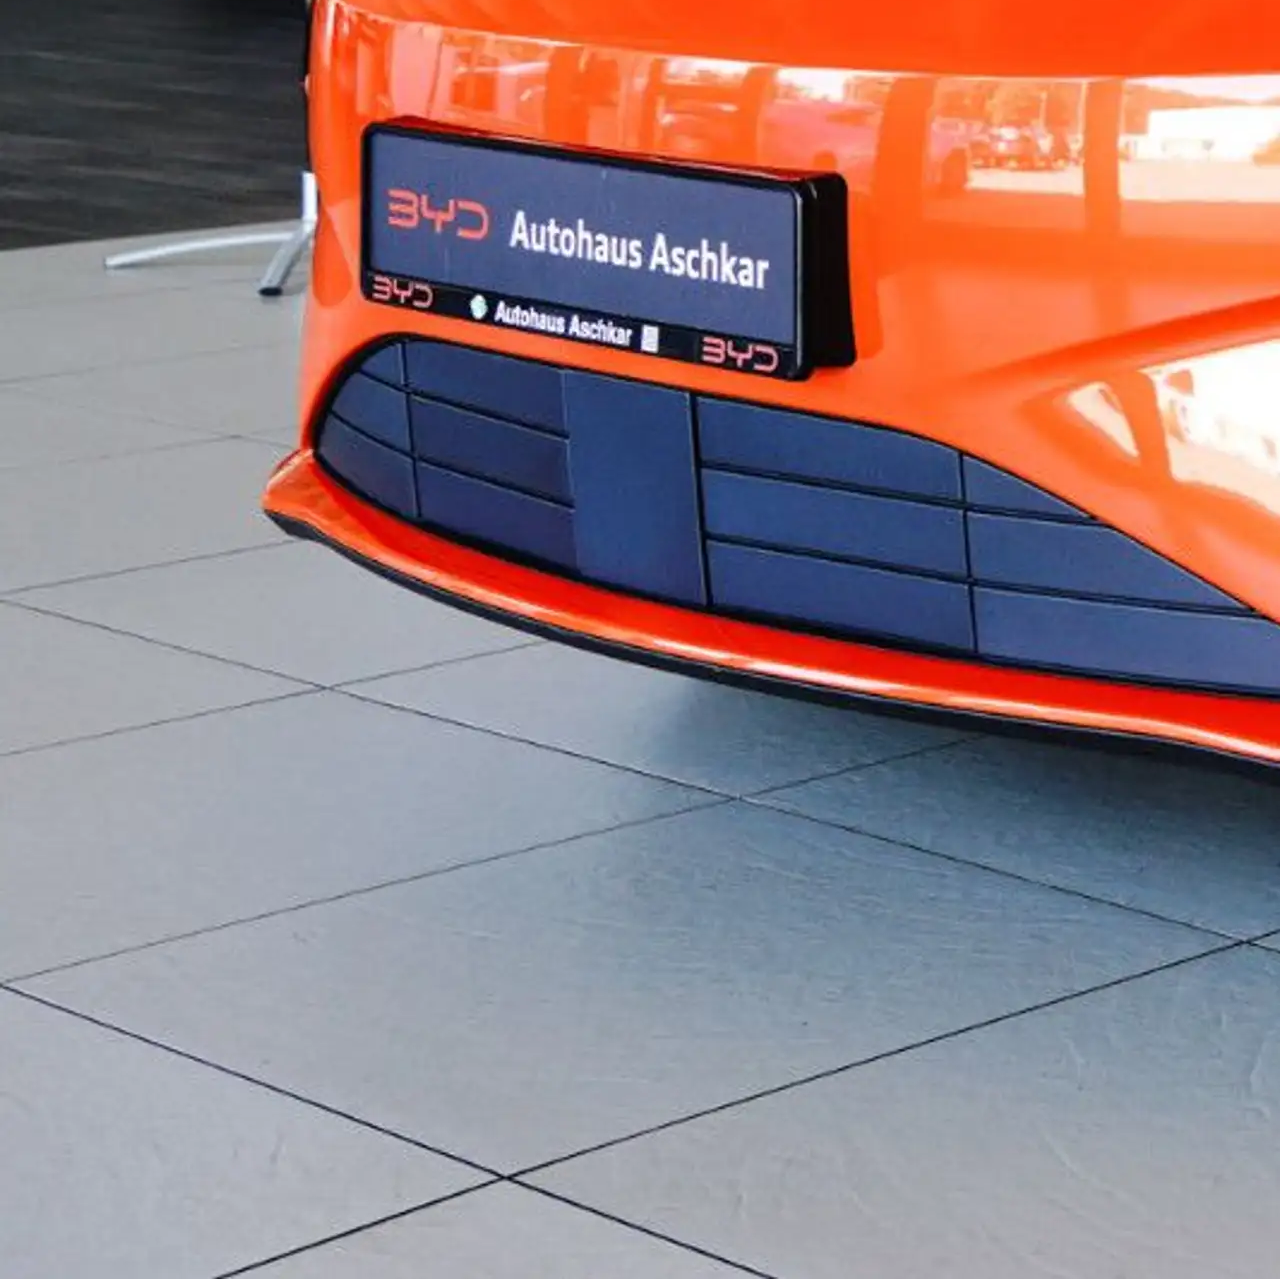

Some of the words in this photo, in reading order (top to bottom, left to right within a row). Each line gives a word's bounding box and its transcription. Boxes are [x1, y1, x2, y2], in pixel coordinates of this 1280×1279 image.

[388, 188, 489, 241] BYD
[508, 209, 642, 270] Autohaus
[650, 232, 770, 289] Aschkar
[372, 274, 433, 309] BYD
[494, 300, 566, 334] Autohaus
[568, 314, 633, 346] Aschkar
[702, 335, 779, 373] BYD
